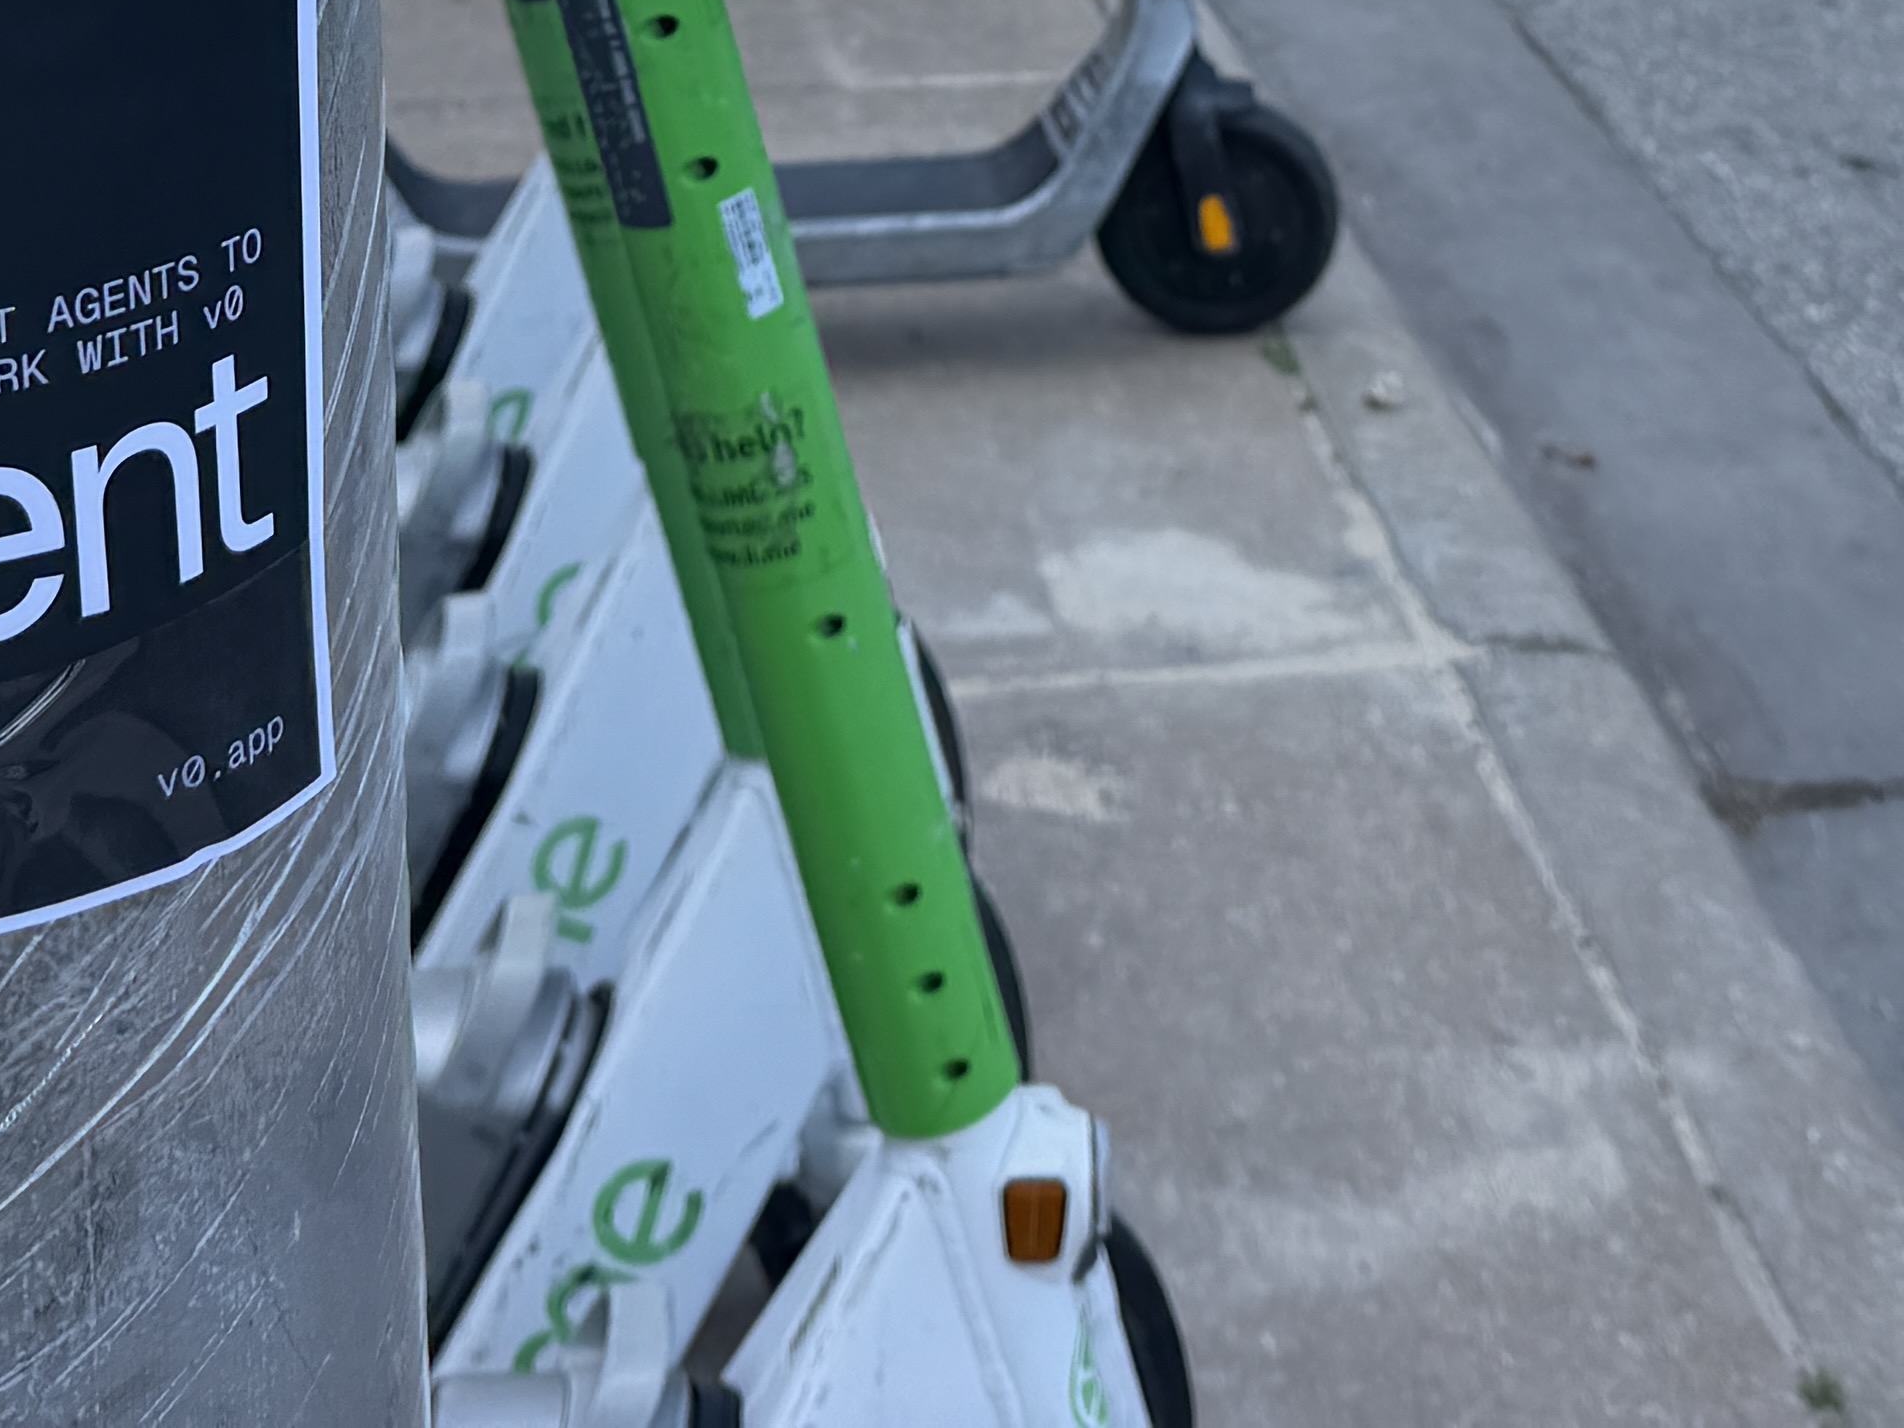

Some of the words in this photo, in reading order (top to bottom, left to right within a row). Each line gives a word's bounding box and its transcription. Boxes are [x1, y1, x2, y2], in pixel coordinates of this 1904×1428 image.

[48, 256, 200, 334] AGENTS
[221, 228, 262, 272] TO
[77, 319, 178, 375] WITH
[157, 714, 284, 798] v0.app
